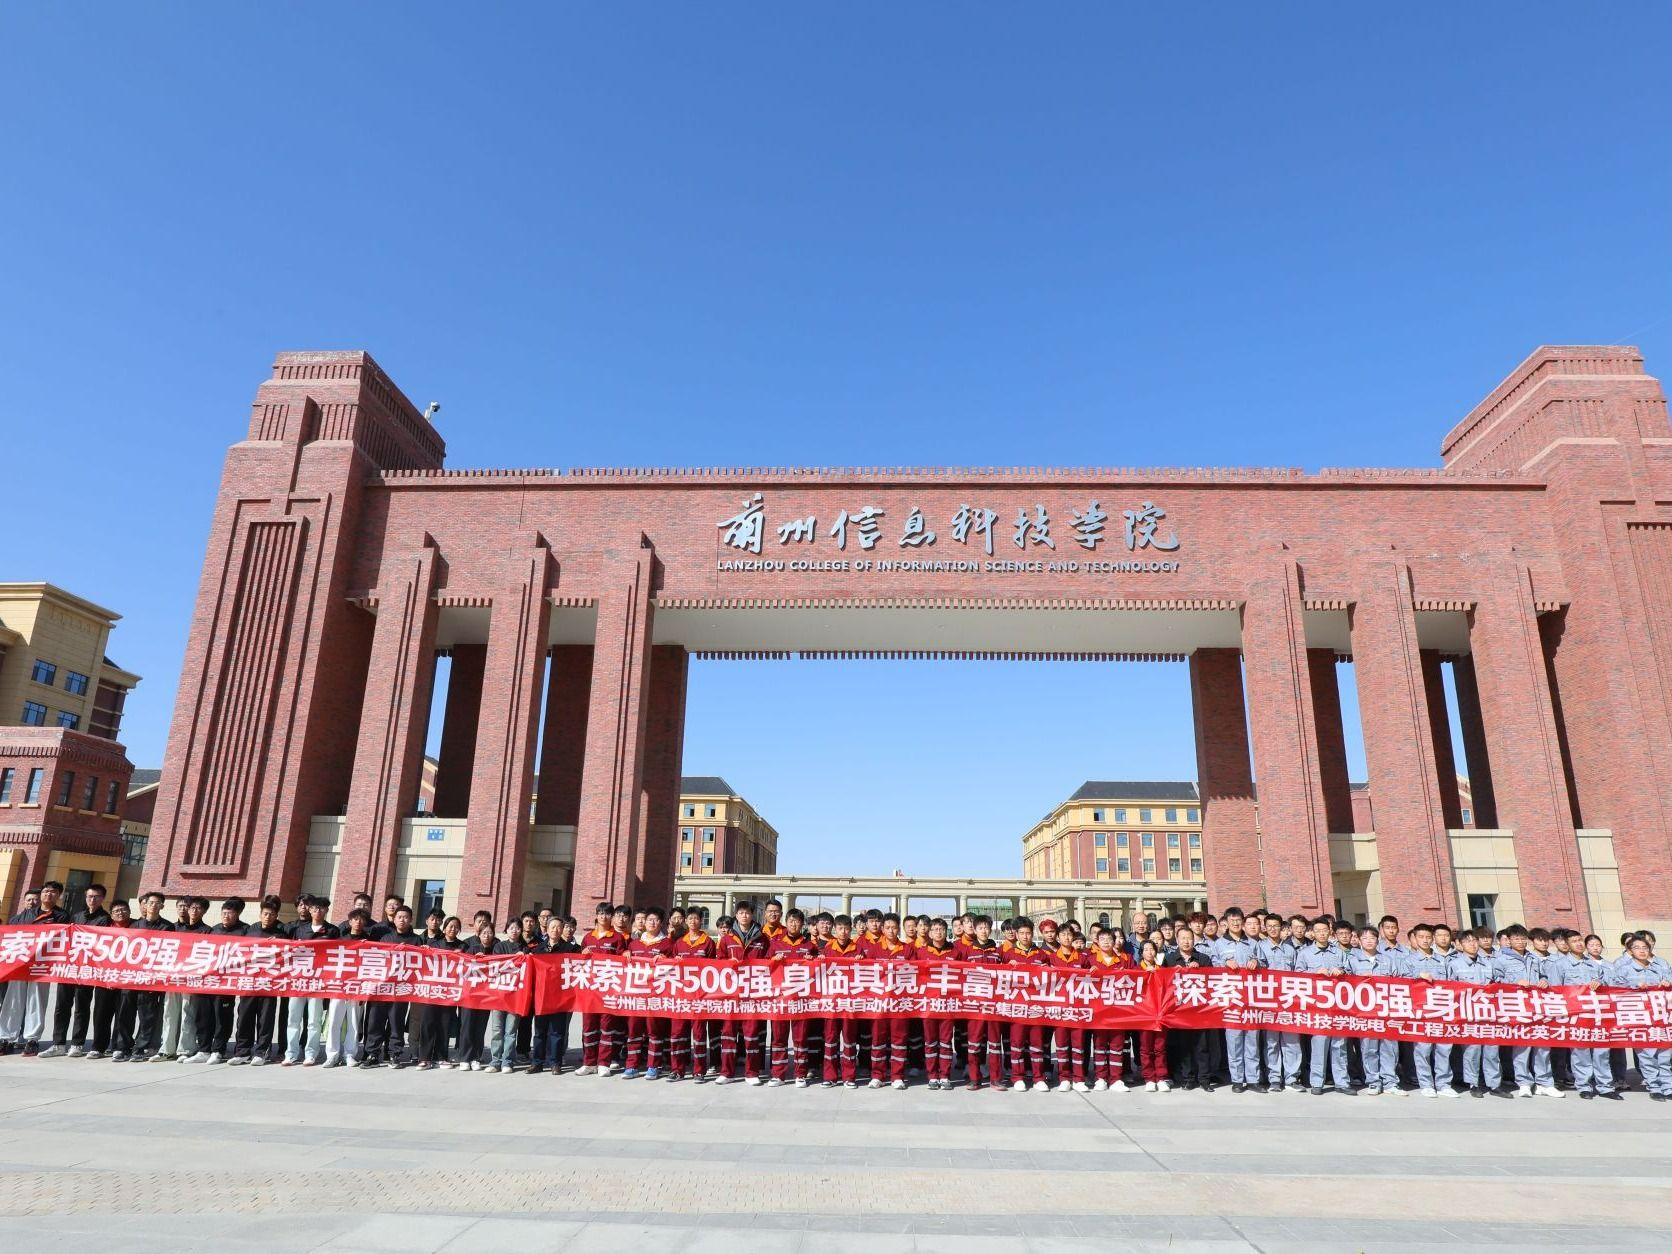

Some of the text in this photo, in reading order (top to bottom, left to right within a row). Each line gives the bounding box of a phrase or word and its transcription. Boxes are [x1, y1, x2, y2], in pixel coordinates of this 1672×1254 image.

[717, 559, 1180, 572] LANZHOU COLLEGE OF INFORMATION SCIENCE AND TECHNOLOGY
[603, 994, 1093, 1022] 兰州信息科技学院机械设计制造及其自动化英才班赴兰石集团参观实习
